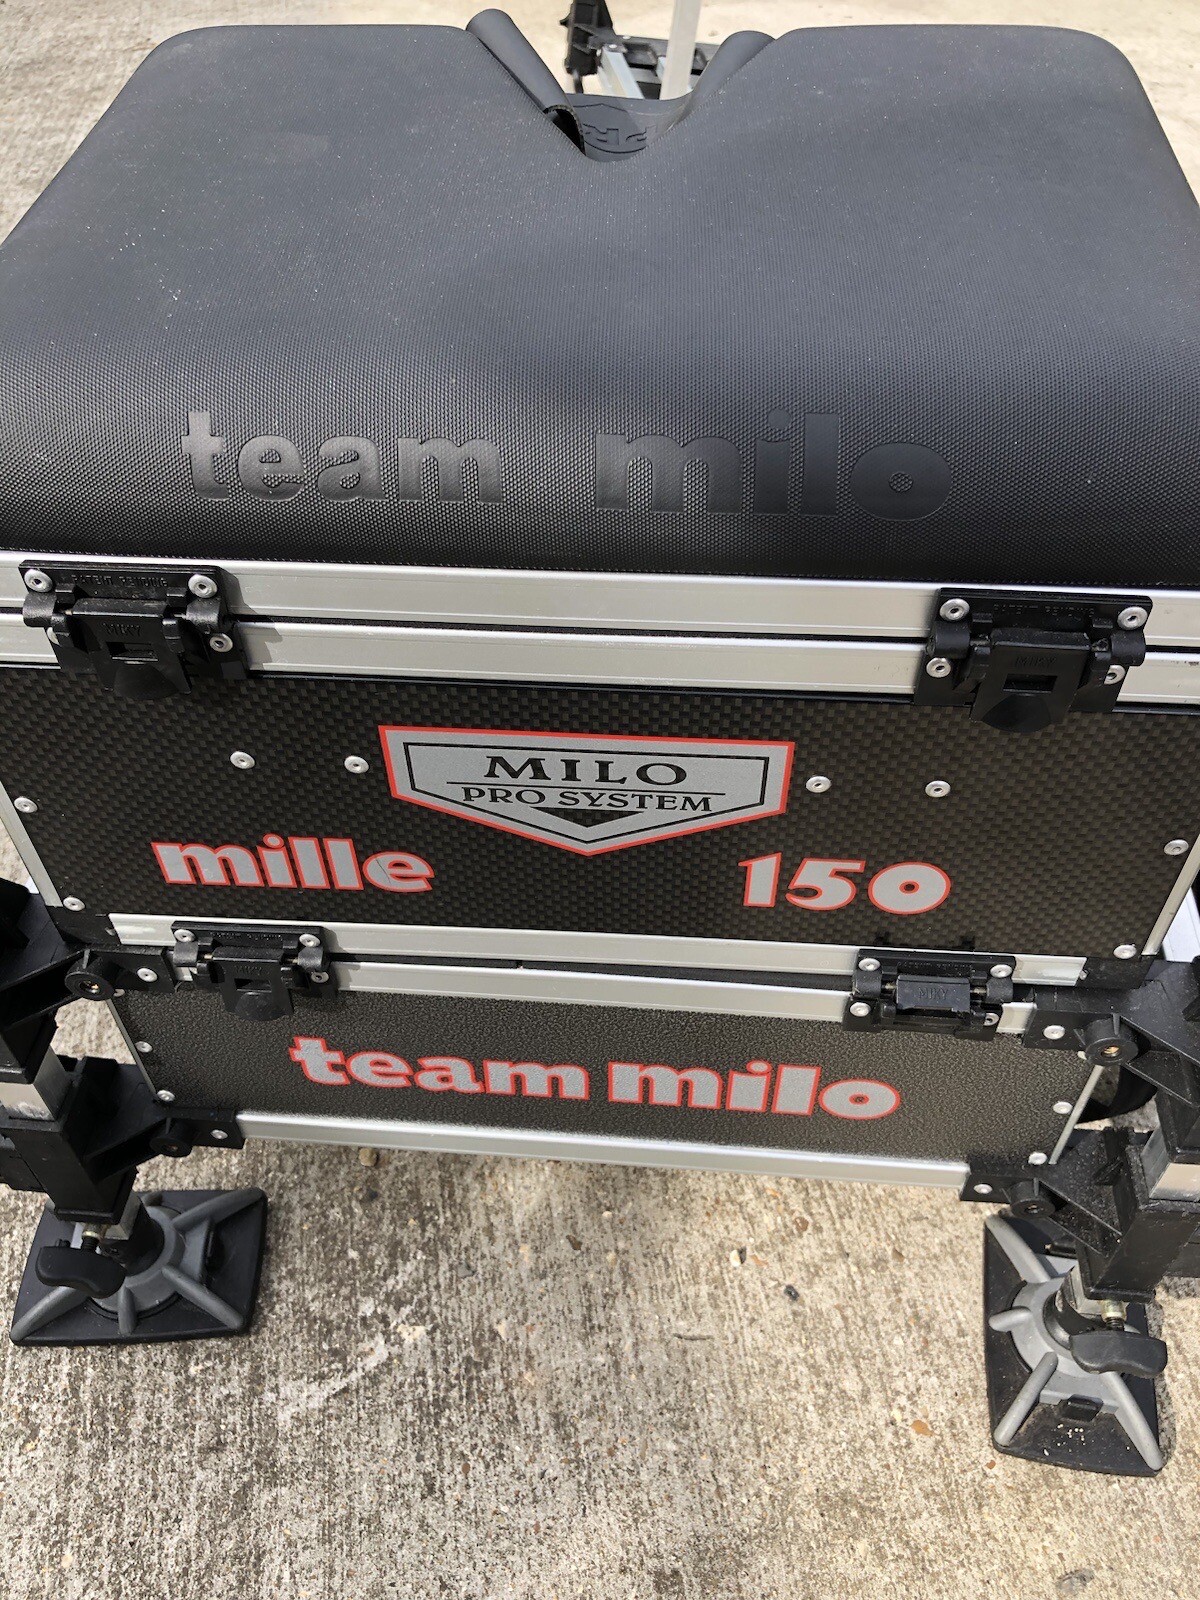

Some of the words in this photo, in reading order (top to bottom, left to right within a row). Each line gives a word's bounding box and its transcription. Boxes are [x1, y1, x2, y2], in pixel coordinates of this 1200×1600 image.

[181, 411, 503, 505] team
[595, 408, 953, 522] milo
[462, 786, 546, 805] PRO
[557, 791, 713, 812] SYSTEM
[483, 755, 687, 786] MILO
[151, 833, 435, 892] mille
[738, 852, 951, 915] 150
[289, 1036, 590, 1100] team
[608, 1060, 901, 1120] milo
